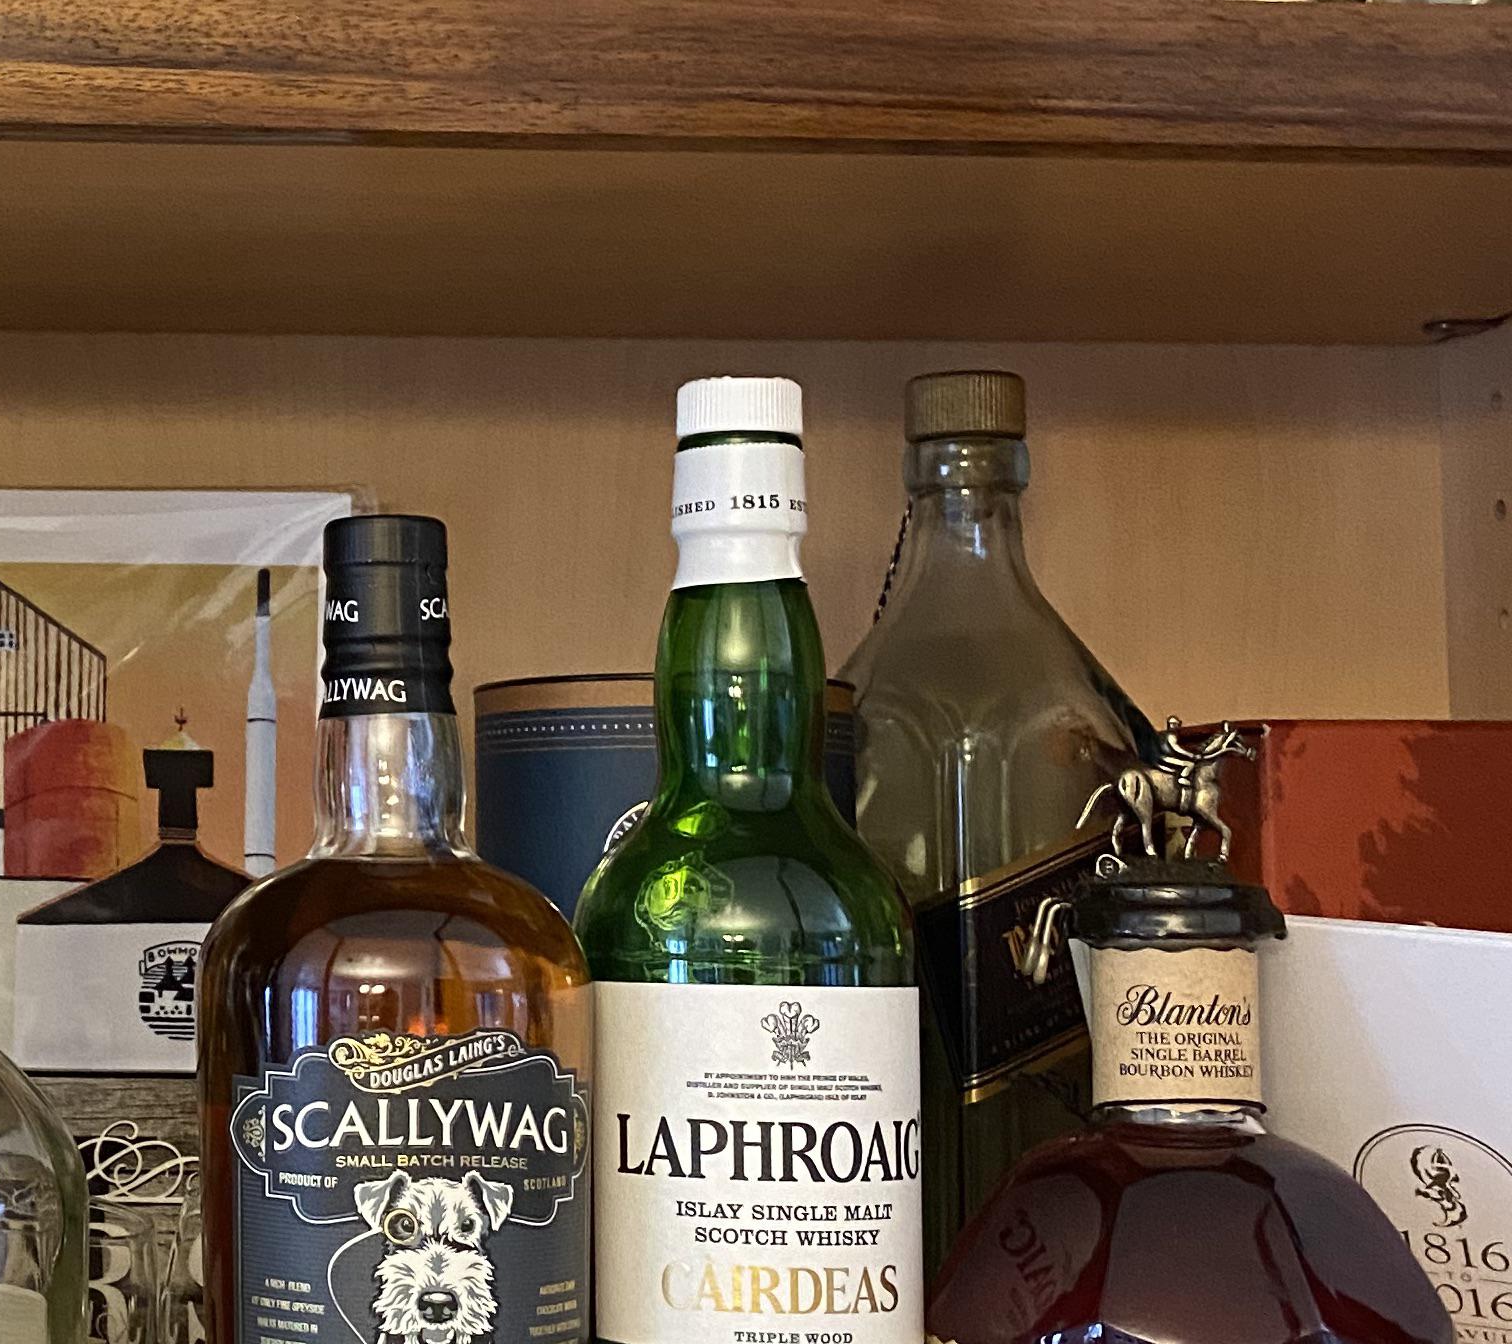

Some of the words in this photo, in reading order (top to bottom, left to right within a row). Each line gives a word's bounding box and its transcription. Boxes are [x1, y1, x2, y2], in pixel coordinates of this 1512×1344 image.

[730, 495, 780, 509] 1815
[1117, 984, 1251, 1026] Blanton's
[1136, 1032, 1170, 1045] THE
[1175, 1032, 1242, 1048] ORIGINAL
[369, 1054, 443, 1088] DOUGLAS
[449, 1034, 506, 1065] LAING'S
[1131, 1048, 1187, 1062] SINGLE
[1193, 1049, 1246, 1064] BARREL
[1120, 1063, 1194, 1080] BOURBON
[1200, 1064, 1254, 1079] WHISKEY
[272, 1098, 568, 1153] SCALLYWAG
[336, 1155, 392, 1167] SMALL
[398, 1154, 455, 1167] BATCH
[460, 1156, 528, 1170] RELEASE
[279, 1172, 321, 1188] PRODUCT
[324, 1177, 337, 1188] OF
[677, 1201, 743, 1219] ISLAY
[752, 1204, 837, 1221] SINGLE
[844, 1204, 893, 1221] MALT
[695, 1227, 788, 1246] SCOTCH
[796, 1229, 880, 1246] WHISKY
[735, 1331, 800, 1344] TRIPLE
[805, 1332, 853, 1344] WOOD
